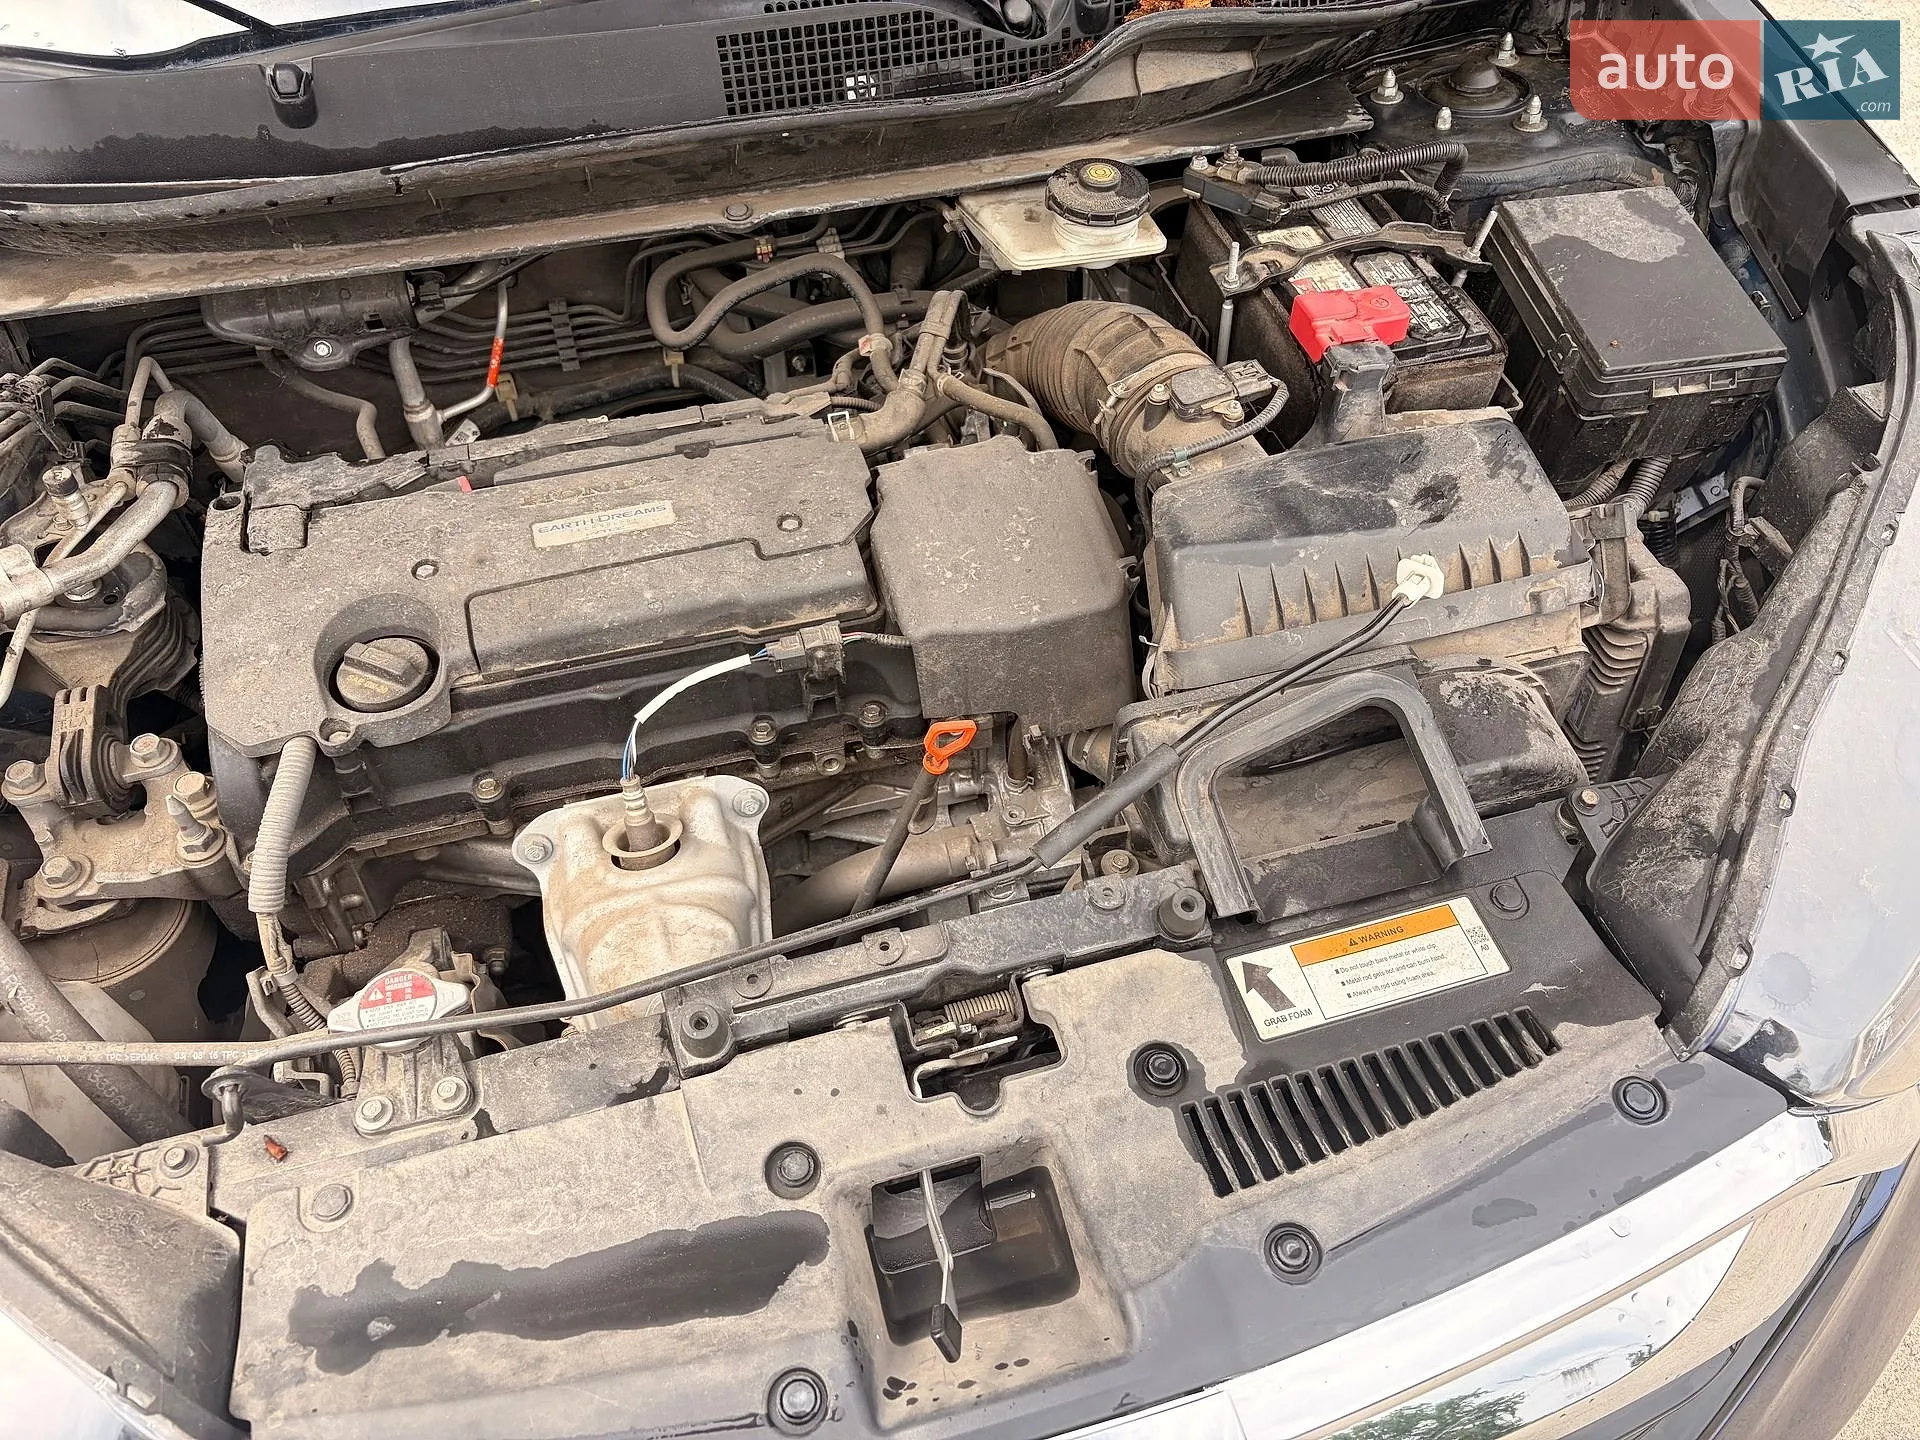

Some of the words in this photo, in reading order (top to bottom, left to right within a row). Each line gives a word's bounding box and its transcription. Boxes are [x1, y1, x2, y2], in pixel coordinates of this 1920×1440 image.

[538, 517, 596, 534] EARTH
[597, 504, 667, 522] DREAMS
[1358, 926, 1404, 942] WARNING
[1340, 966, 1349, 974] Do
[1350, 964, 1359, 972] not
[1359, 959, 1375, 968] touch
[1375, 956, 1388, 965] bare
[1389, 951, 1404, 961] metal
[1411, 945, 1426, 954] white
[1345, 976, 1362, 986] Metal
[1362, 974, 1372, 982] rod
[1372, 970, 1385, 979] gets
[1386, 967, 1395, 976] hot
[1396, 963, 1406, 972] and
[1406, 961, 1417, 969] can
[1417, 957, 1430, 966] burn
[1352, 988, 1372, 998] Always
[1372, 985, 1381, 993] lift
[1381, 981, 1391, 990] rod
[1391, 977, 1406, 987] using
[1405, 973, 1421, 983] foam
[1264, 1014, 1288, 1026] GRAB
[1288, 1008, 1312, 1020] FOAM
